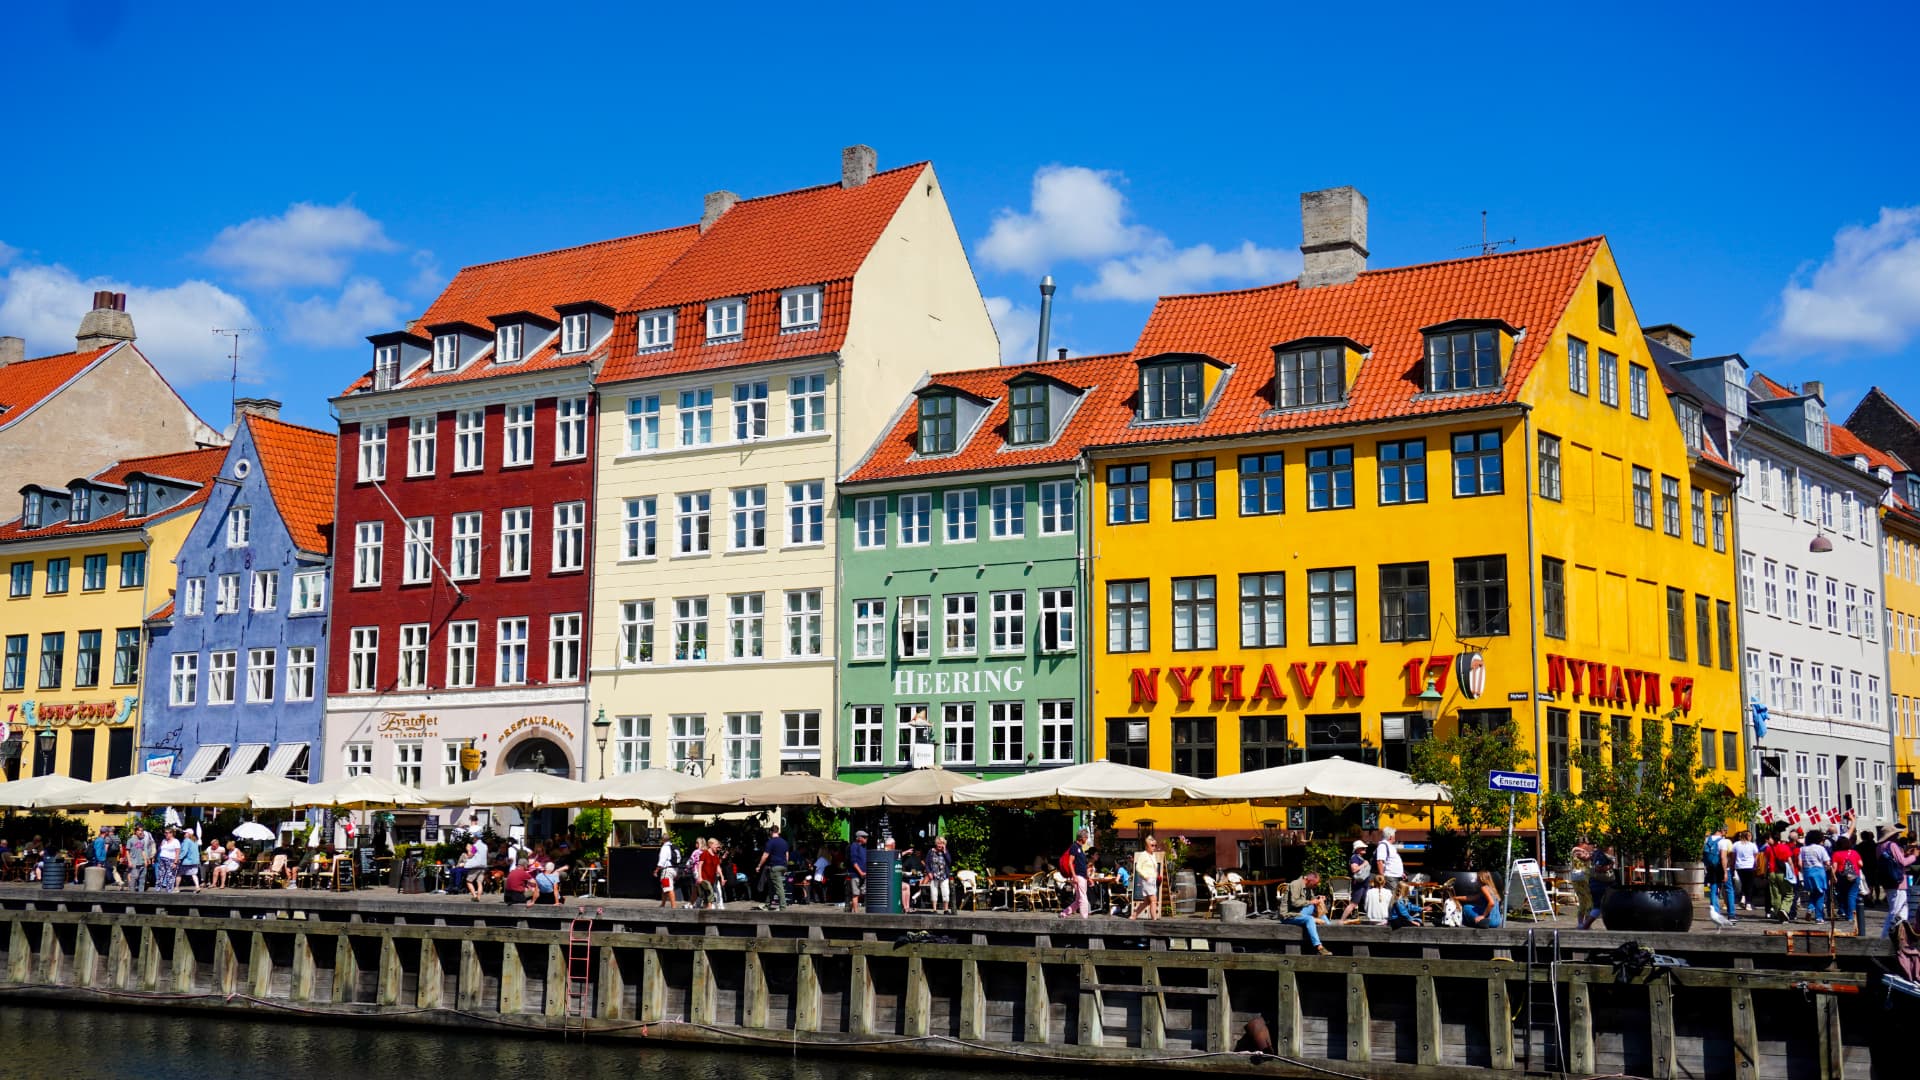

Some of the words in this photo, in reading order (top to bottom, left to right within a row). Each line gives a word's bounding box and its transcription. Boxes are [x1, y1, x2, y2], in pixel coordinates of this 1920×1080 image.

[892, 666, 1025, 696] HEERING
[1131, 660, 1368, 703] NYHAVN
[1403, 654, 1455, 698] 17
[1546, 653, 1661, 707] NYHAVN
[1670, 676, 1694, 712] 17
[502, 715, 570, 738] RESTAURANT
[1500, 777, 1535, 787] Ensrettet
